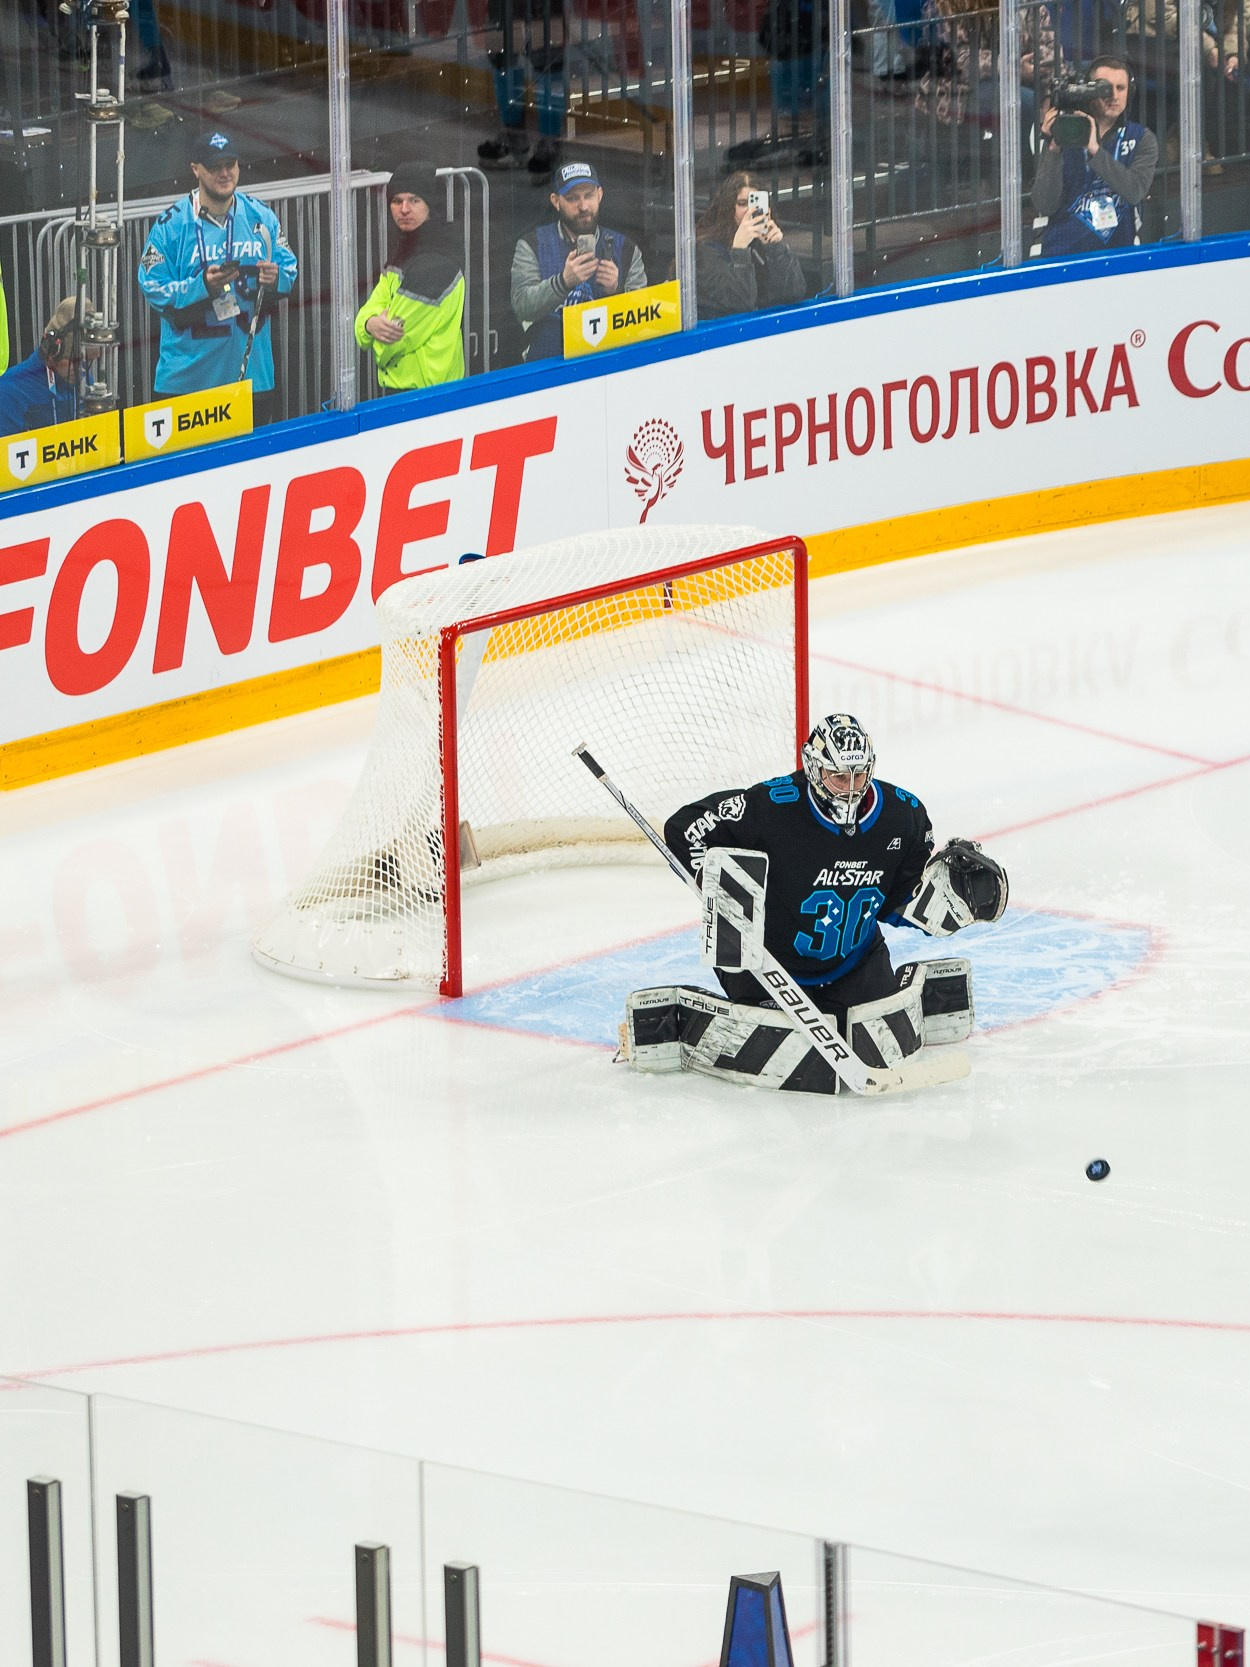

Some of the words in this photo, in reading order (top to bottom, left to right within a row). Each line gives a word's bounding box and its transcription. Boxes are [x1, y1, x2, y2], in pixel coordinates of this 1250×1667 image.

[612, 303, 662, 331] БАНК
[178, 403, 232, 432] БАНК
[42, 434, 98, 463] БАНК
[833, 860, 869, 869] FONBET
[942, 891, 965, 922] TRUE
[705, 896, 714, 955] TRUE
[793, 887, 886, 961] 30
[899, 965, 914, 988] TRUE
[680, 996, 730, 1016] TRUE
